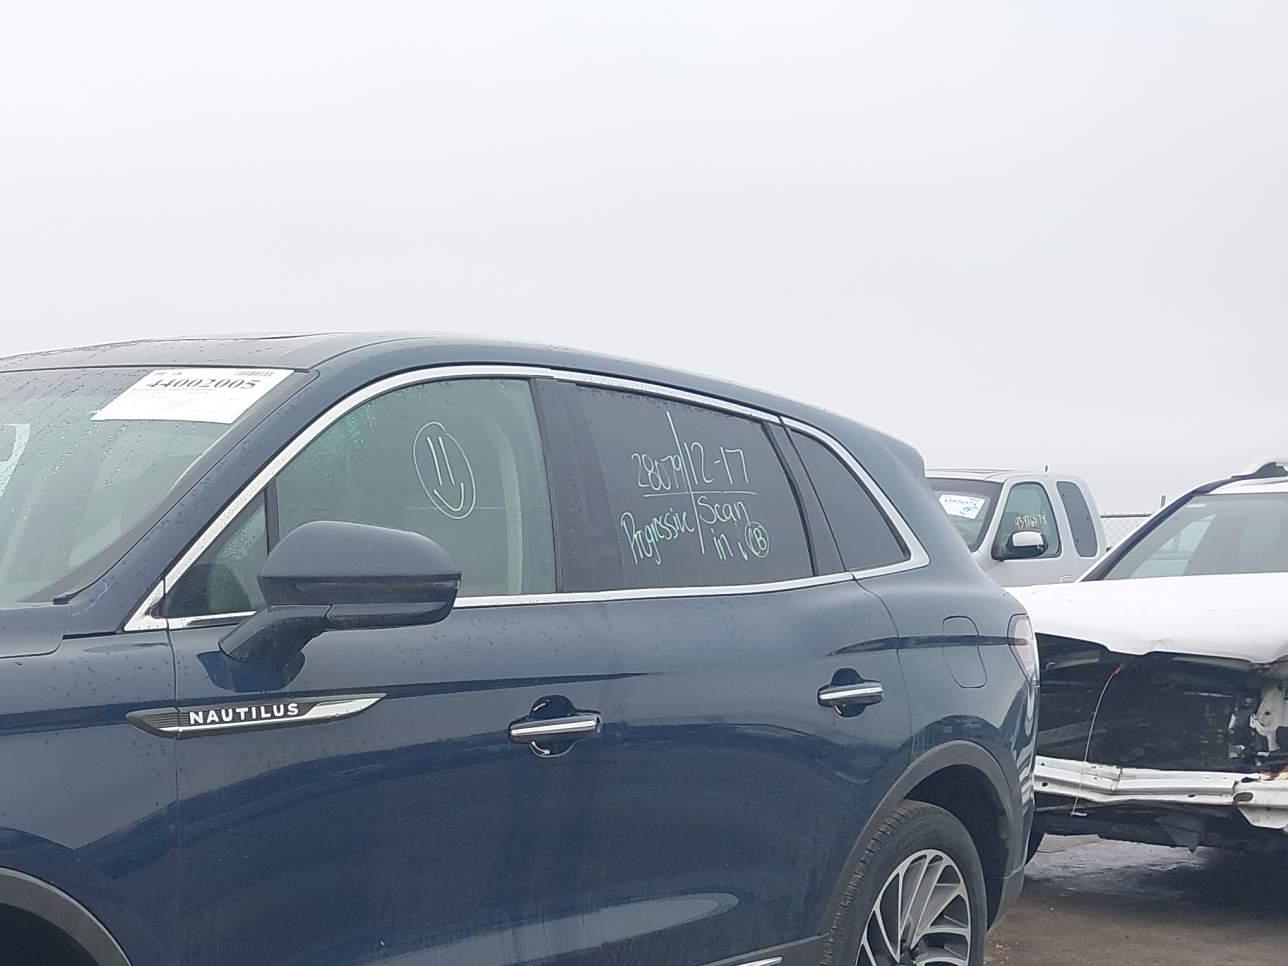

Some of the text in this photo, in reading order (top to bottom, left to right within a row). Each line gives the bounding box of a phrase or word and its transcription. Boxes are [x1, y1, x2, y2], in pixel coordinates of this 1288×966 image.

[684, 442, 749, 485] 12-17
[697, 495, 751, 527] Scan
[189, 703, 299, 725] NAUTILUS
